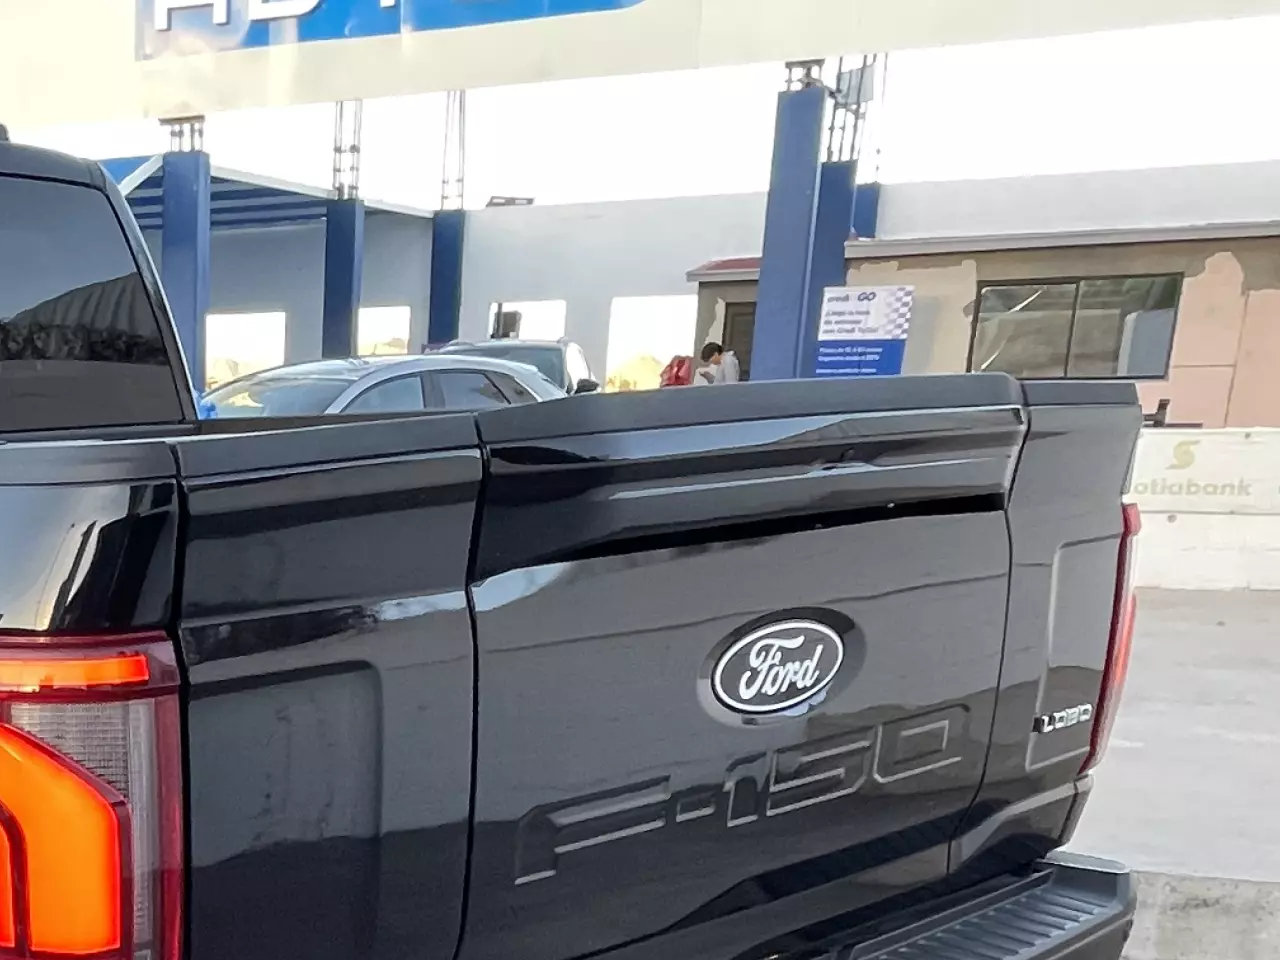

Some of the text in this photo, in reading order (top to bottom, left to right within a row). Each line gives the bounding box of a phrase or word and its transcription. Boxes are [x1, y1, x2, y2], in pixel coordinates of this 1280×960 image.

[1133, 477, 1252, 496] otiabank
[739, 635, 823, 700] Ford
[515, 702, 970, 885] F-150
